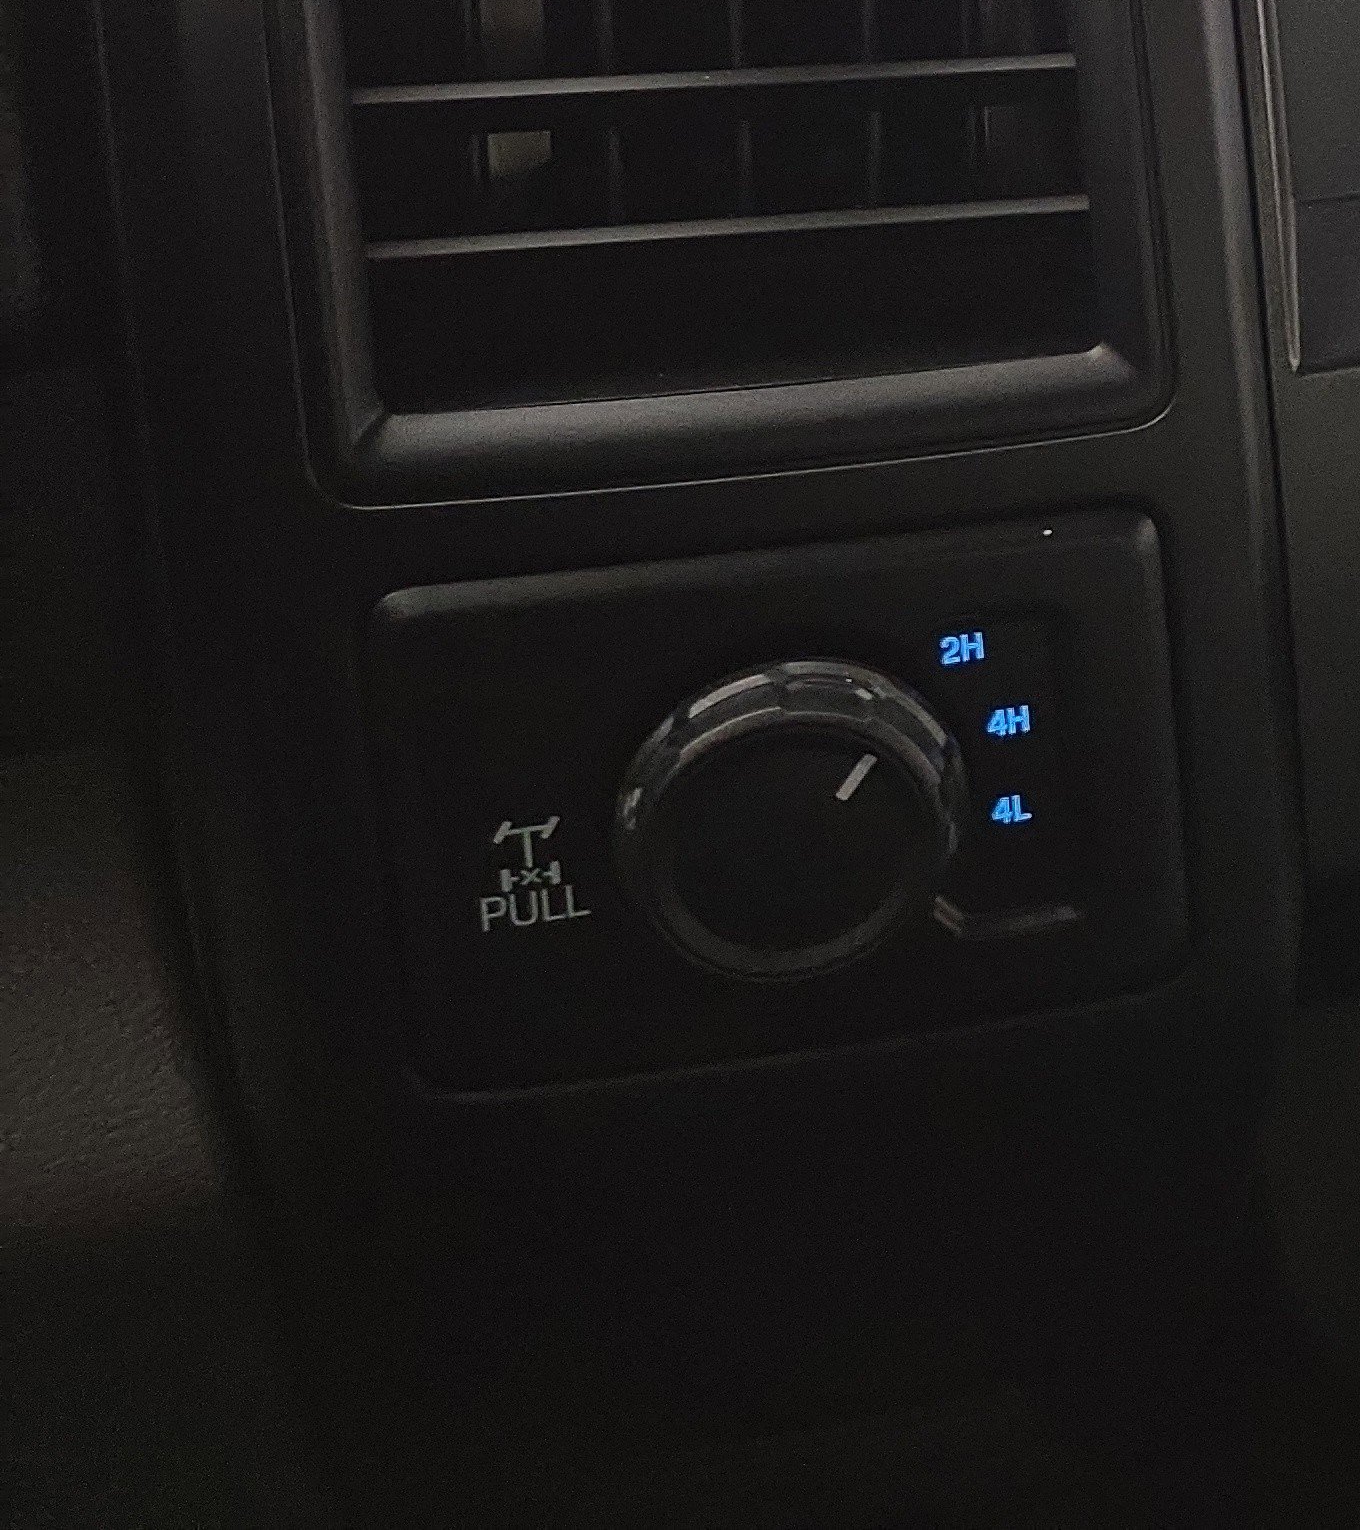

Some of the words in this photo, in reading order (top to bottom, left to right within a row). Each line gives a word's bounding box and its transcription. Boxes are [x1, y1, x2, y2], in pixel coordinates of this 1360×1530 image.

[939, 630, 986, 667] 2H
[986, 703, 1032, 738] 4H
[991, 793, 1033, 826] 4L
[478, 884, 592, 933] PULL
